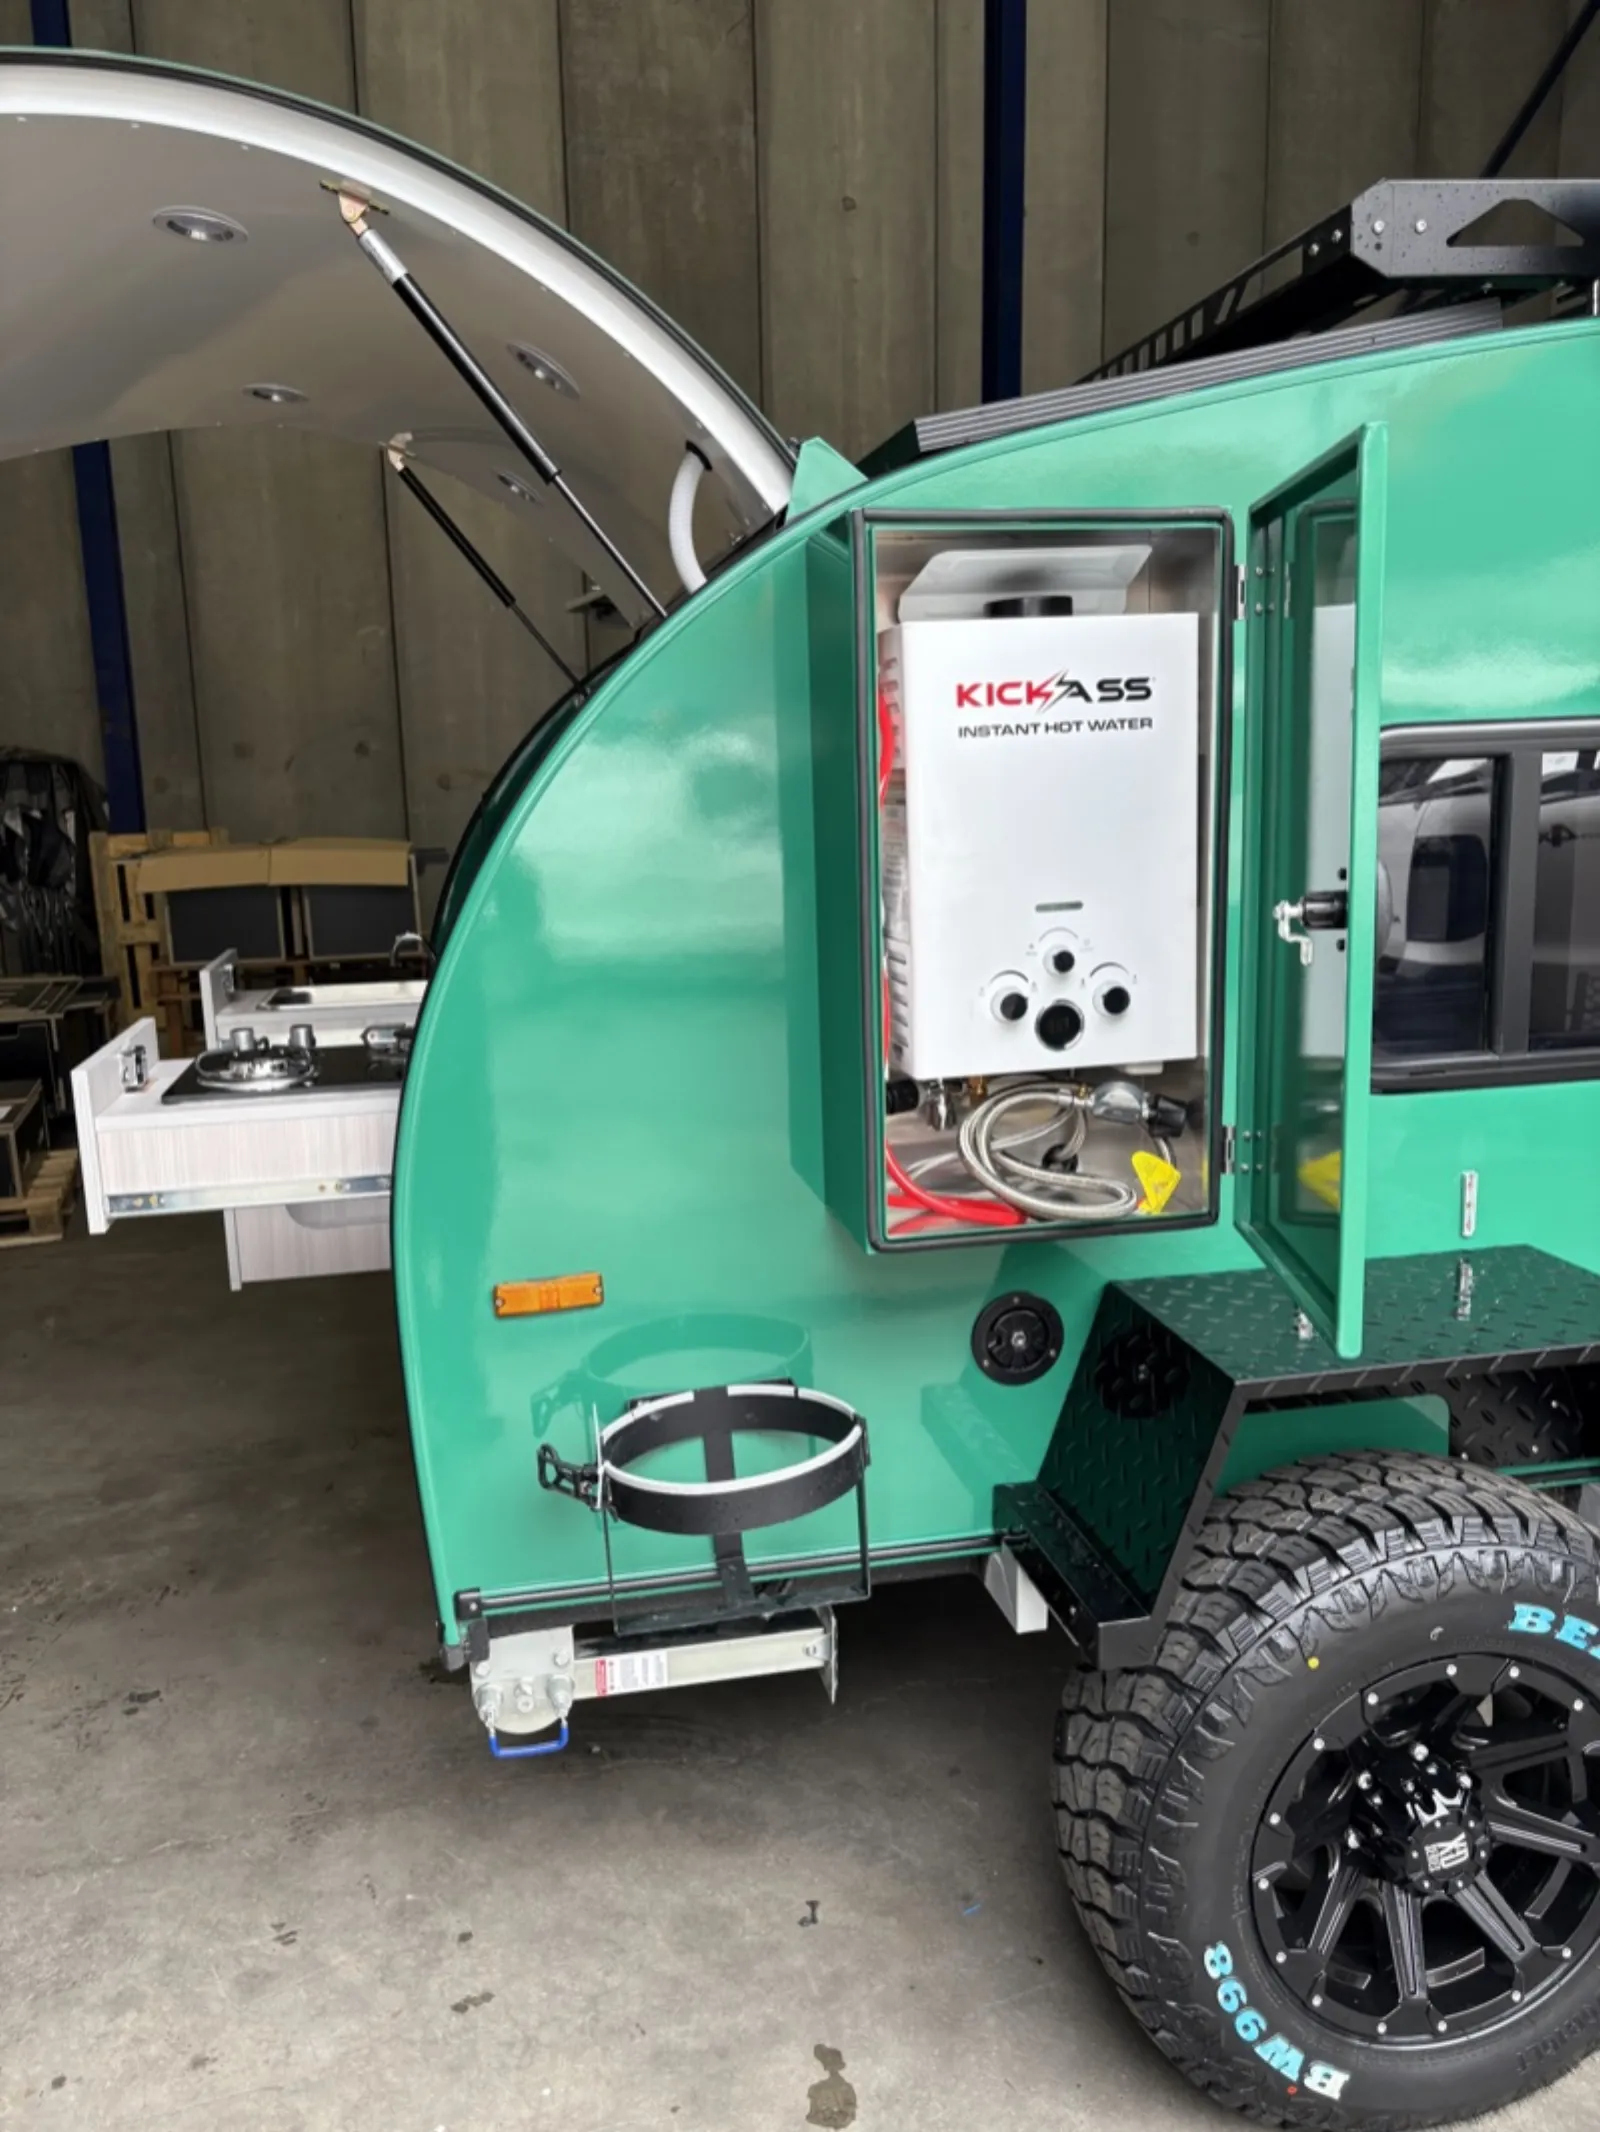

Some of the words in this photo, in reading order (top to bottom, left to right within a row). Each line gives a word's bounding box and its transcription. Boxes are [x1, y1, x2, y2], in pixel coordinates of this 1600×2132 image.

[956, 673, 1153, 711] KICKASS
[958, 723, 1040, 739] INSTANT
[1044, 720, 1083, 734] HOT
[1088, 717, 1153, 732] WATER
[1507, 1602, 1600, 1661] BE
